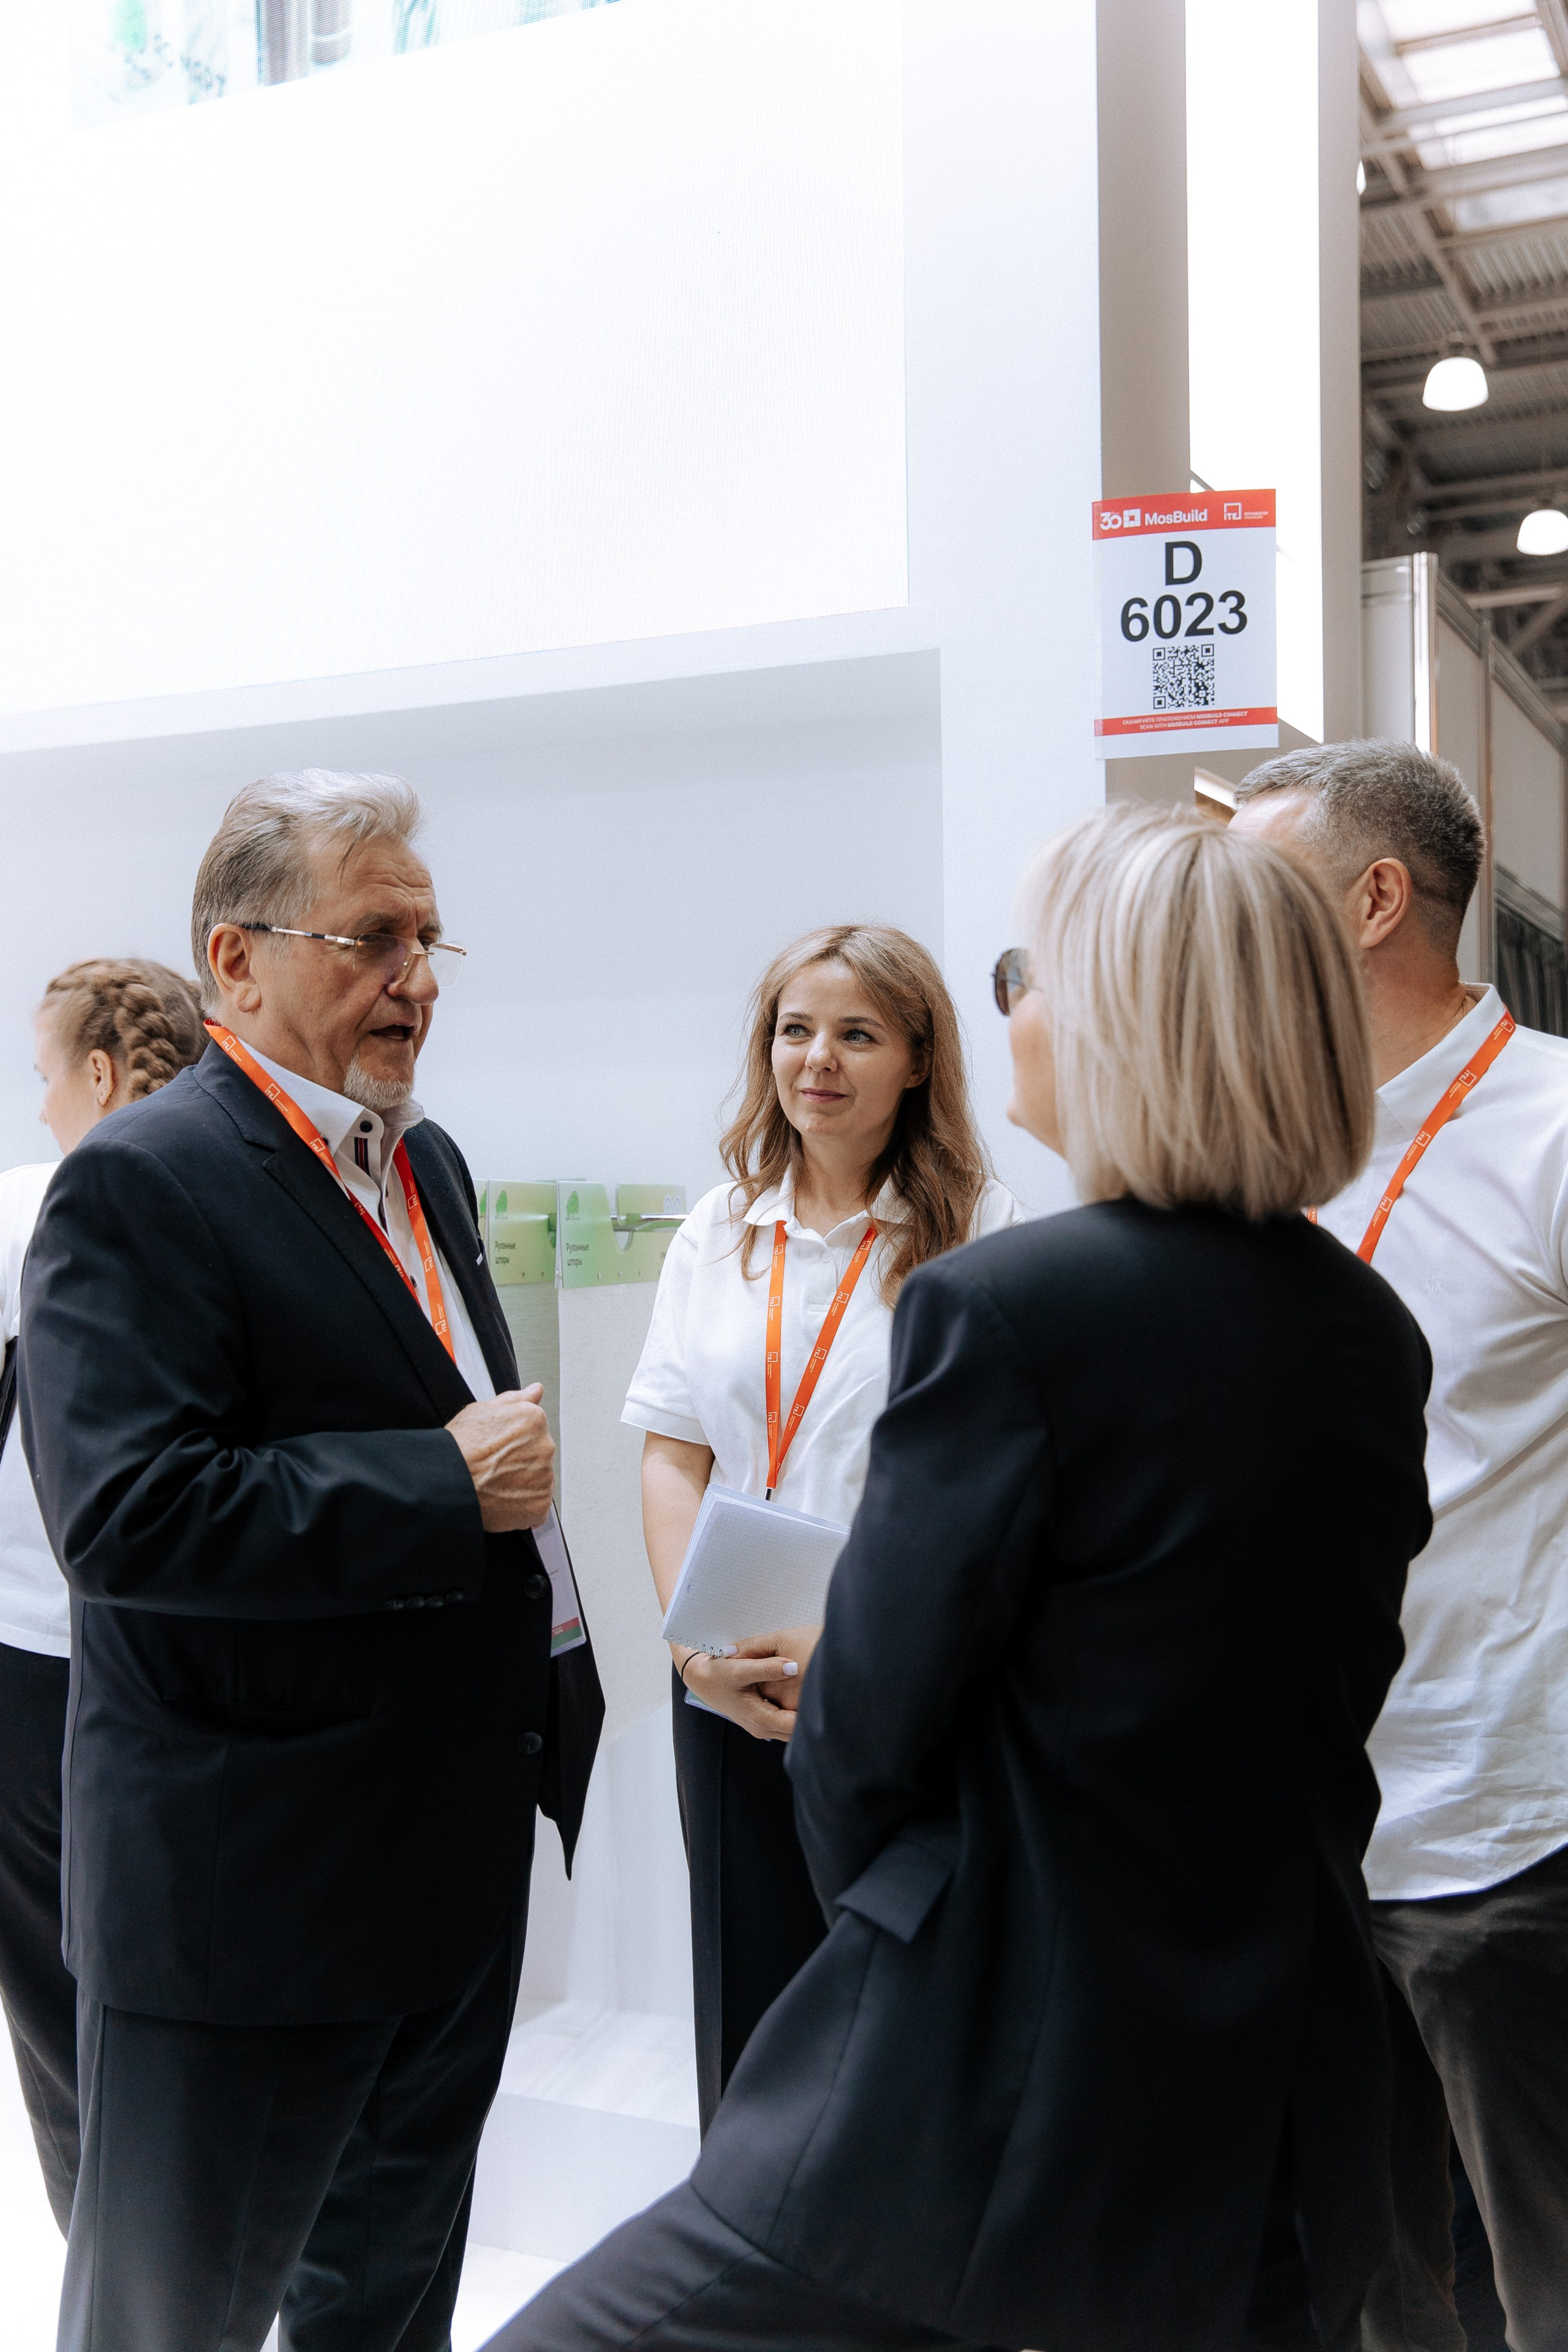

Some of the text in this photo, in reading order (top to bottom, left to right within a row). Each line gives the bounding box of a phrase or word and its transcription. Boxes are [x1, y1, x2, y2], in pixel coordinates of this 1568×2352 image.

[1099, 508, 1208, 530] 30 MosBuild
[1165, 540, 1202, 586] D
[1121, 590, 1248, 643] 6023
[495, 1241, 516, 1251] Рулонные
[566, 1243, 589, 1254] Рулонные
[496, 1257, 510, 1265] шторы
[567, 1259, 582, 1268] шторы
